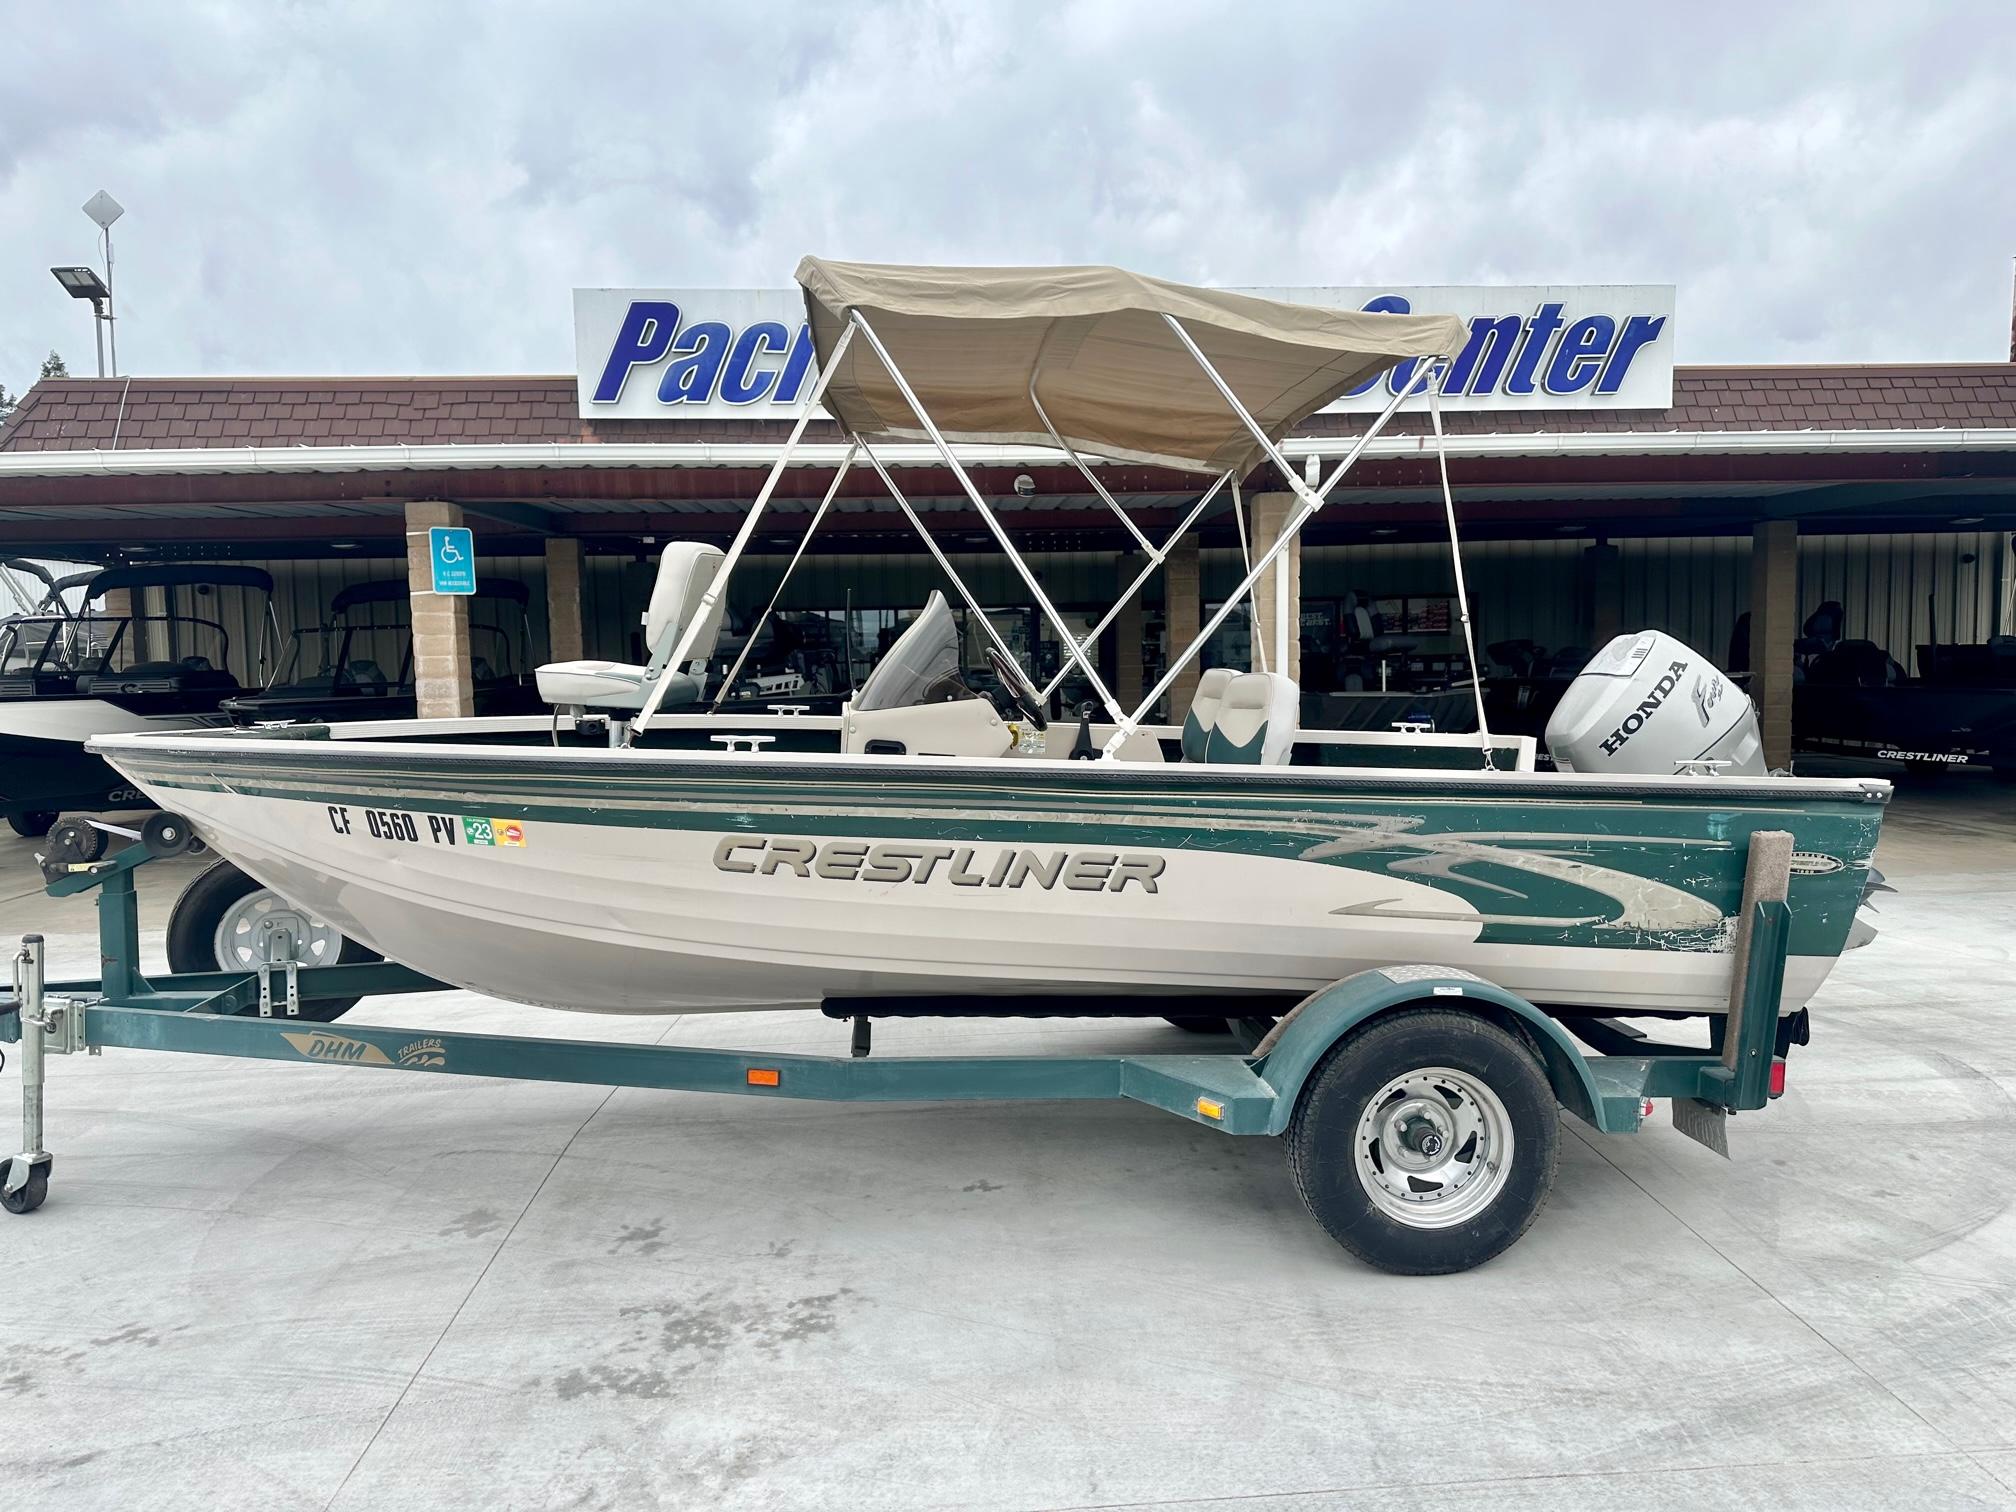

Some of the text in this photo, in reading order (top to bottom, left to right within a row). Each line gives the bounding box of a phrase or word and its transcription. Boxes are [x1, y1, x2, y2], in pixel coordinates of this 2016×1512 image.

[590, 299, 821, 405] Paci
[1599, 660, 1688, 757] HONDA
[1877, 750, 1969, 763] CRESTLINER
[328, 806, 456, 845] CF 0560 PV
[472, 822, 493, 840] 23
[712, 835, 1166, 894] CRESTLINER
[307, 1039, 442, 1061] DHM TRAILERS
